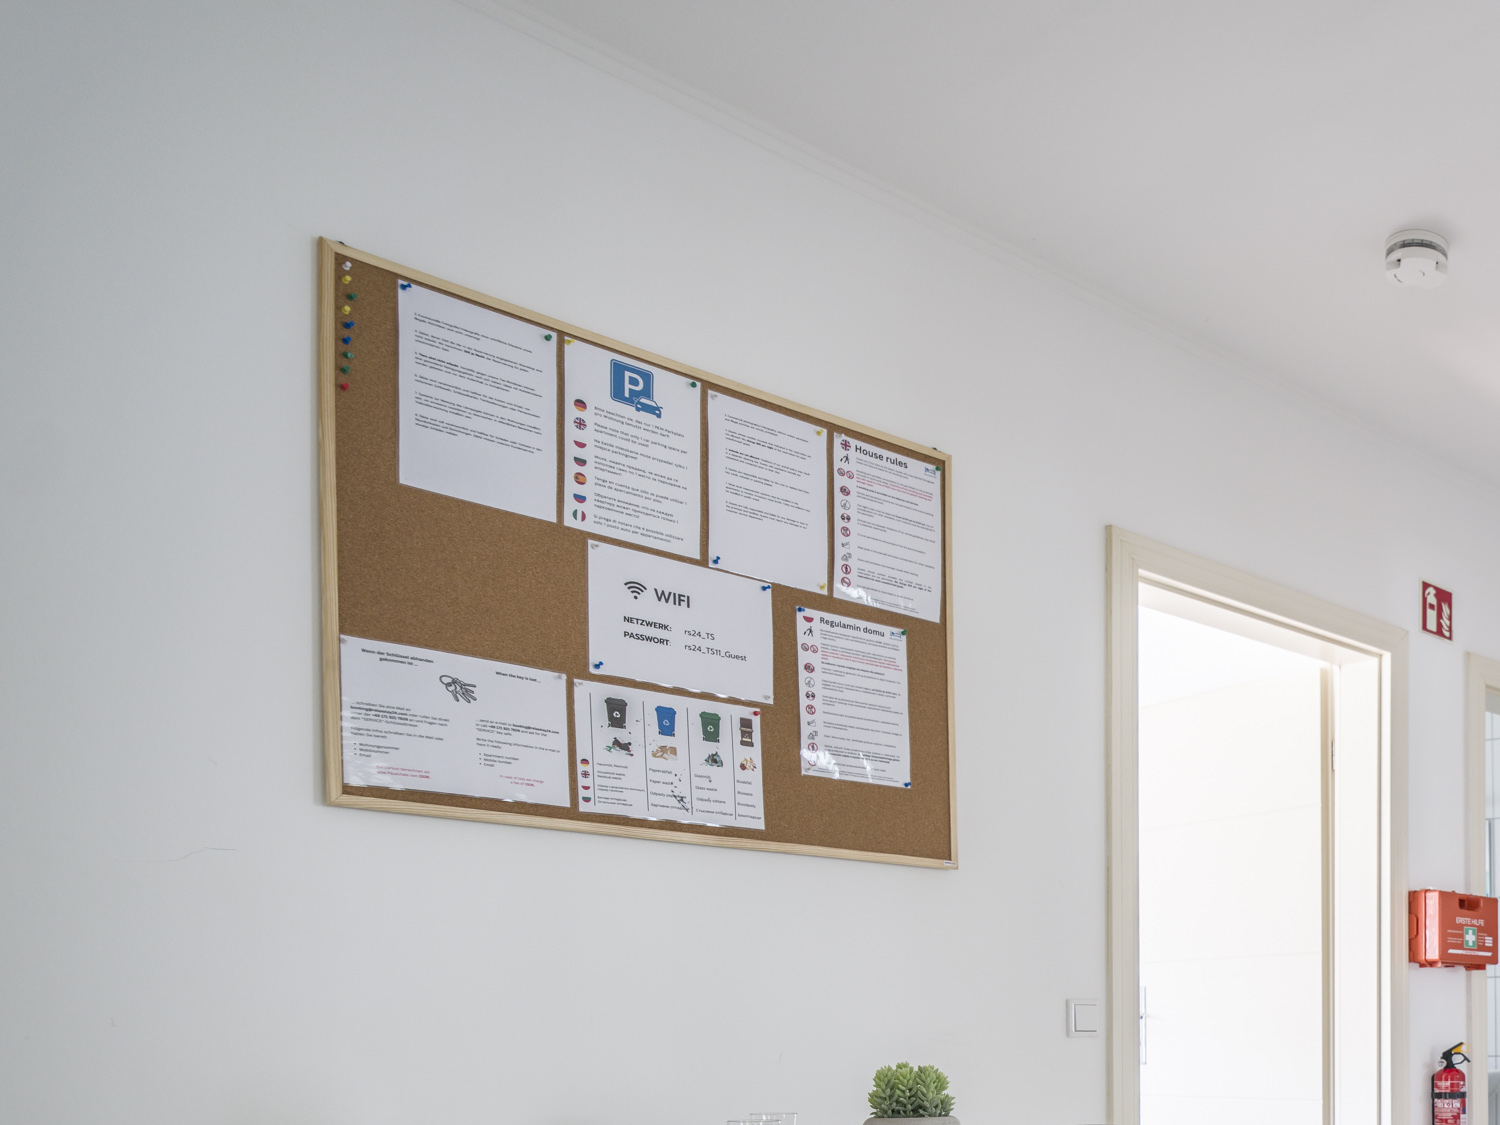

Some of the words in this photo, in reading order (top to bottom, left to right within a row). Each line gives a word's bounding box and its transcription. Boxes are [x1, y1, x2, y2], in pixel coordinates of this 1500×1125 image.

[624, 370, 644, 398] P
[855, 445, 884, 461] House
[886, 456, 908, 469] rules
[654, 588, 690, 608] WIFI
[623, 616, 672, 632] NETZWERK:
[684, 630, 715, 640] rs24_TS
[820, 617, 861, 631] Regulamin
[863, 626, 884, 637] domu
[623, 631, 672, 646] PASSWORT:
[1456, 917, 1471, 925] ERSTE
